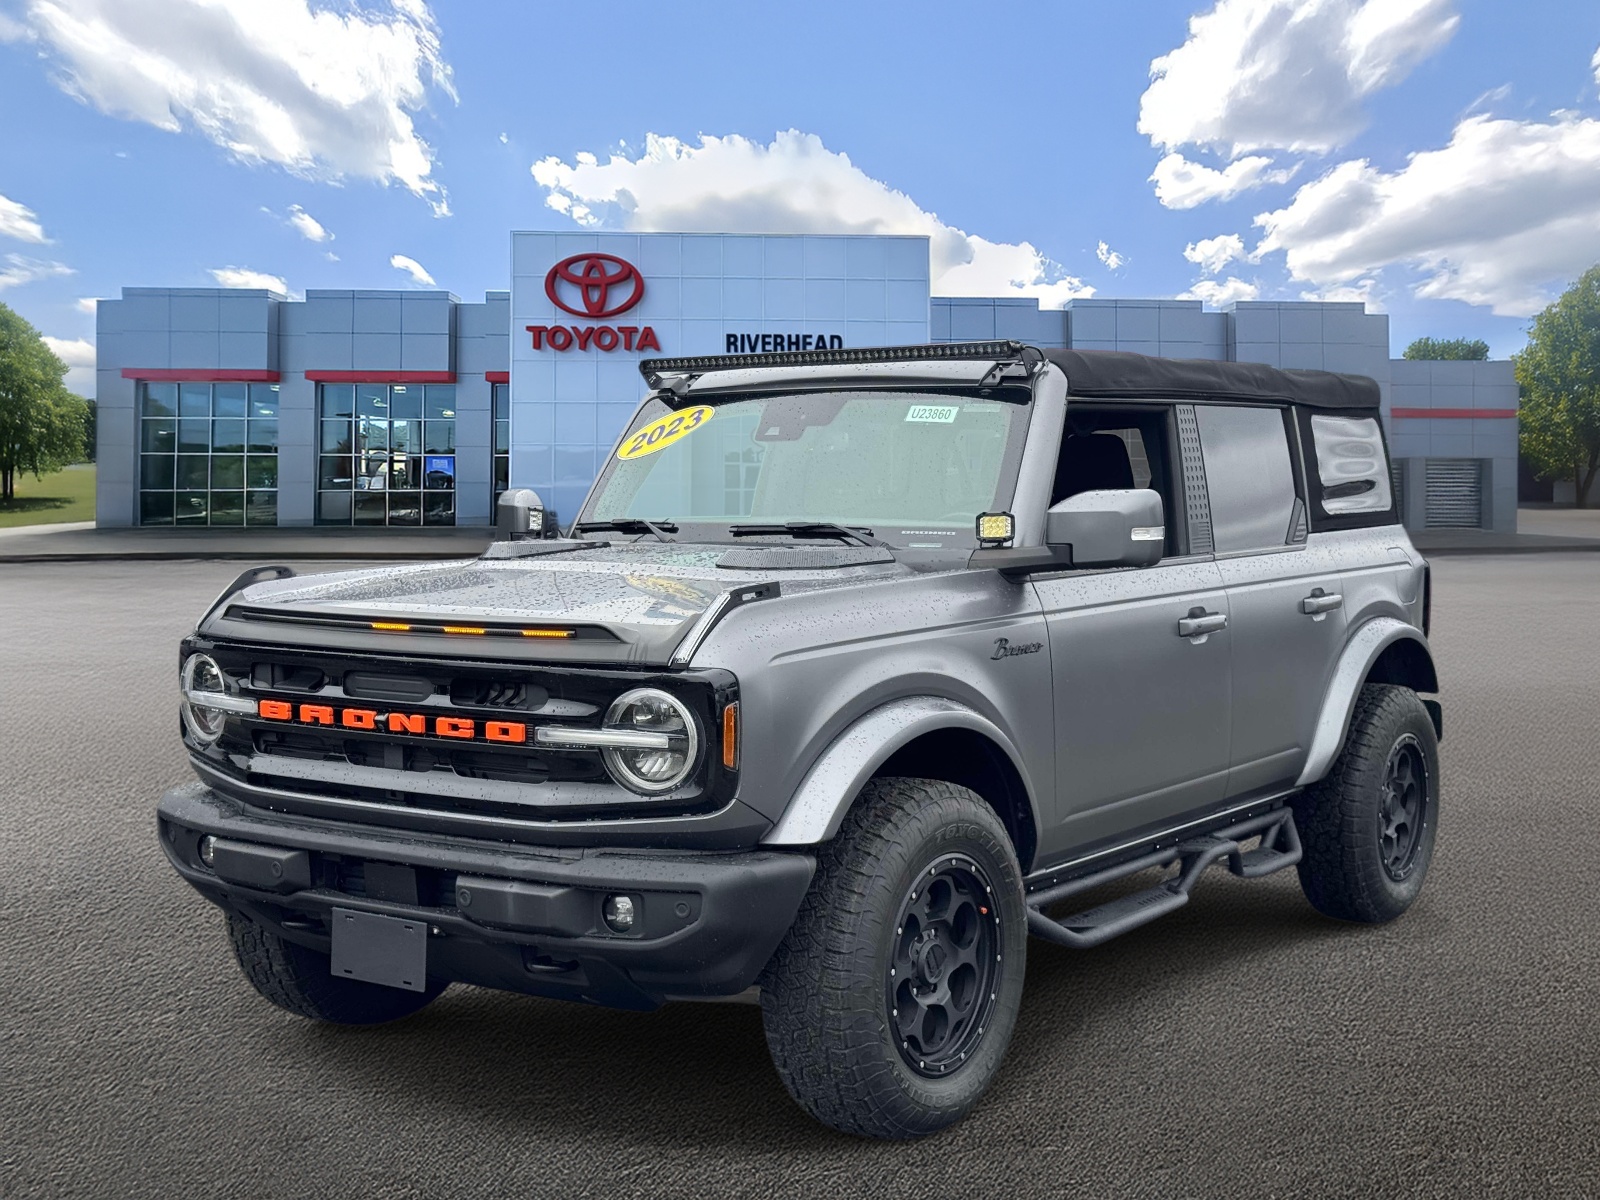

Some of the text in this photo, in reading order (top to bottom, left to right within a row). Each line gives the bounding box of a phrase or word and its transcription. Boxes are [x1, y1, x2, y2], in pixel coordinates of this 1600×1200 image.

[526, 325, 661, 352] TOYOTA
[726, 333, 843, 353] RIVERHEAD
[911, 408, 952, 421] U23860
[626, 407, 705, 457] 2023
[990, 637, 1044, 661] Bronco
[259, 699, 526, 743] BRONCO
[934, 823, 979, 843] TOYO
